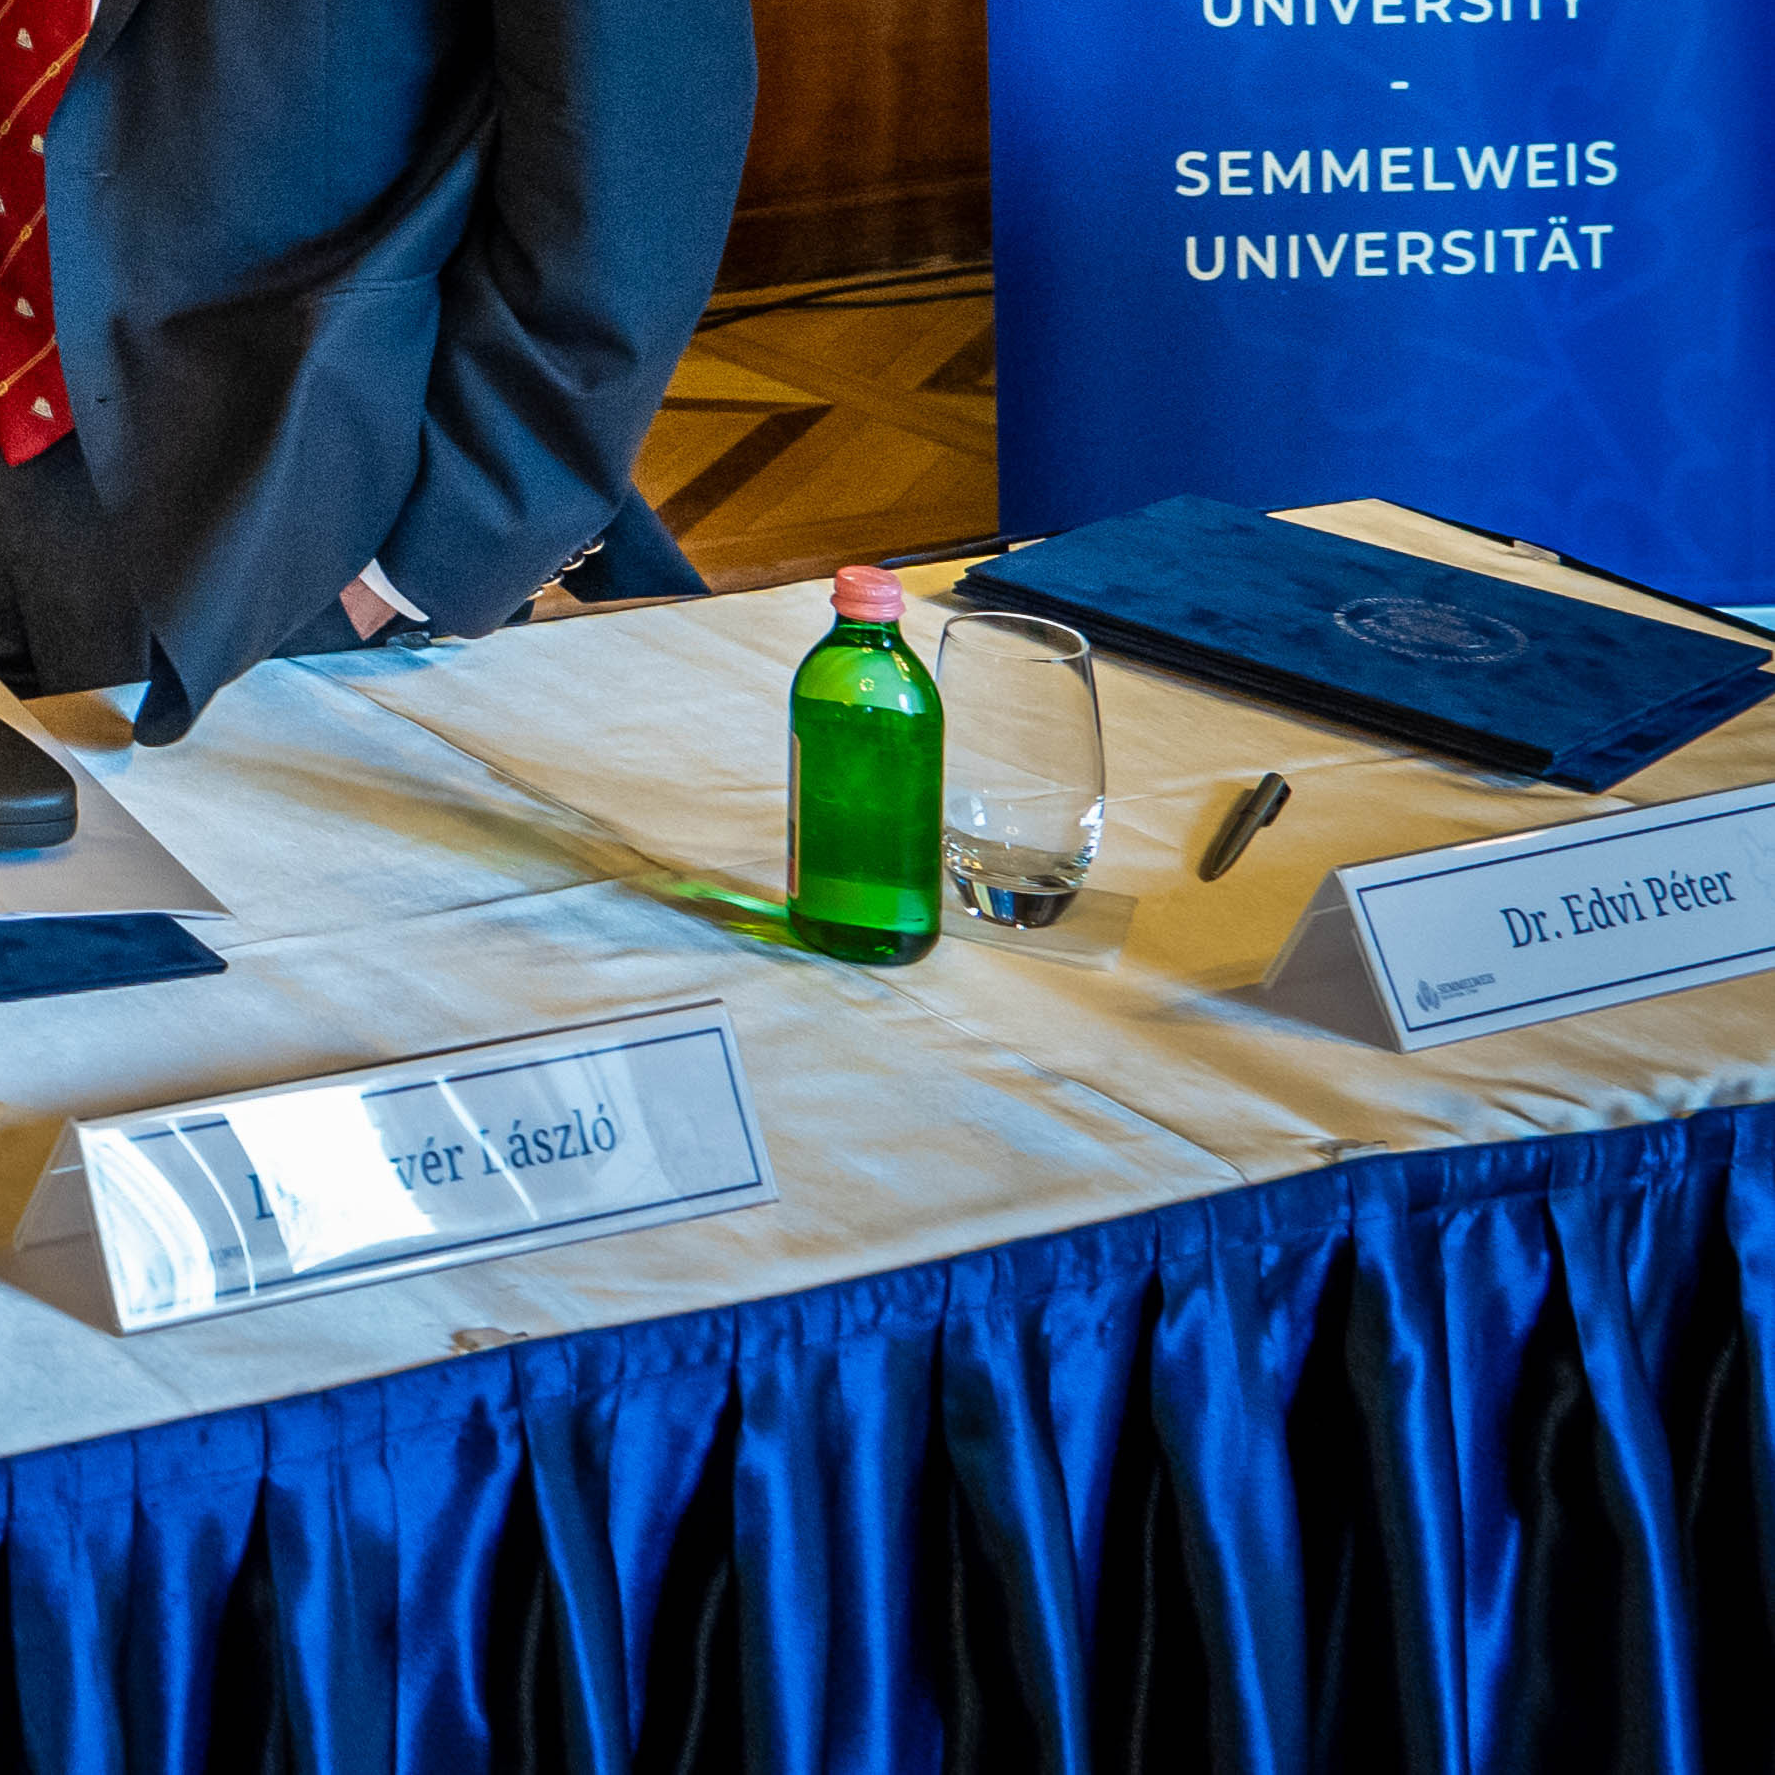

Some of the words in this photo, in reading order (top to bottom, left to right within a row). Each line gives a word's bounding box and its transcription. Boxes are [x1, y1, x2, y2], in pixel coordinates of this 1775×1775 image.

[1175, 140, 1618, 197] SEMMELWEIS
[1185, 215, 1615, 280] UNIVERSITÄT
[1500, 904, 1563, 949] Dr.
[1561, 885, 1650, 937] Edvi
[1643, 868, 1738, 919] Péter
[390, 1137, 465, 1192] vér
[480, 1103, 619, 1177] László
